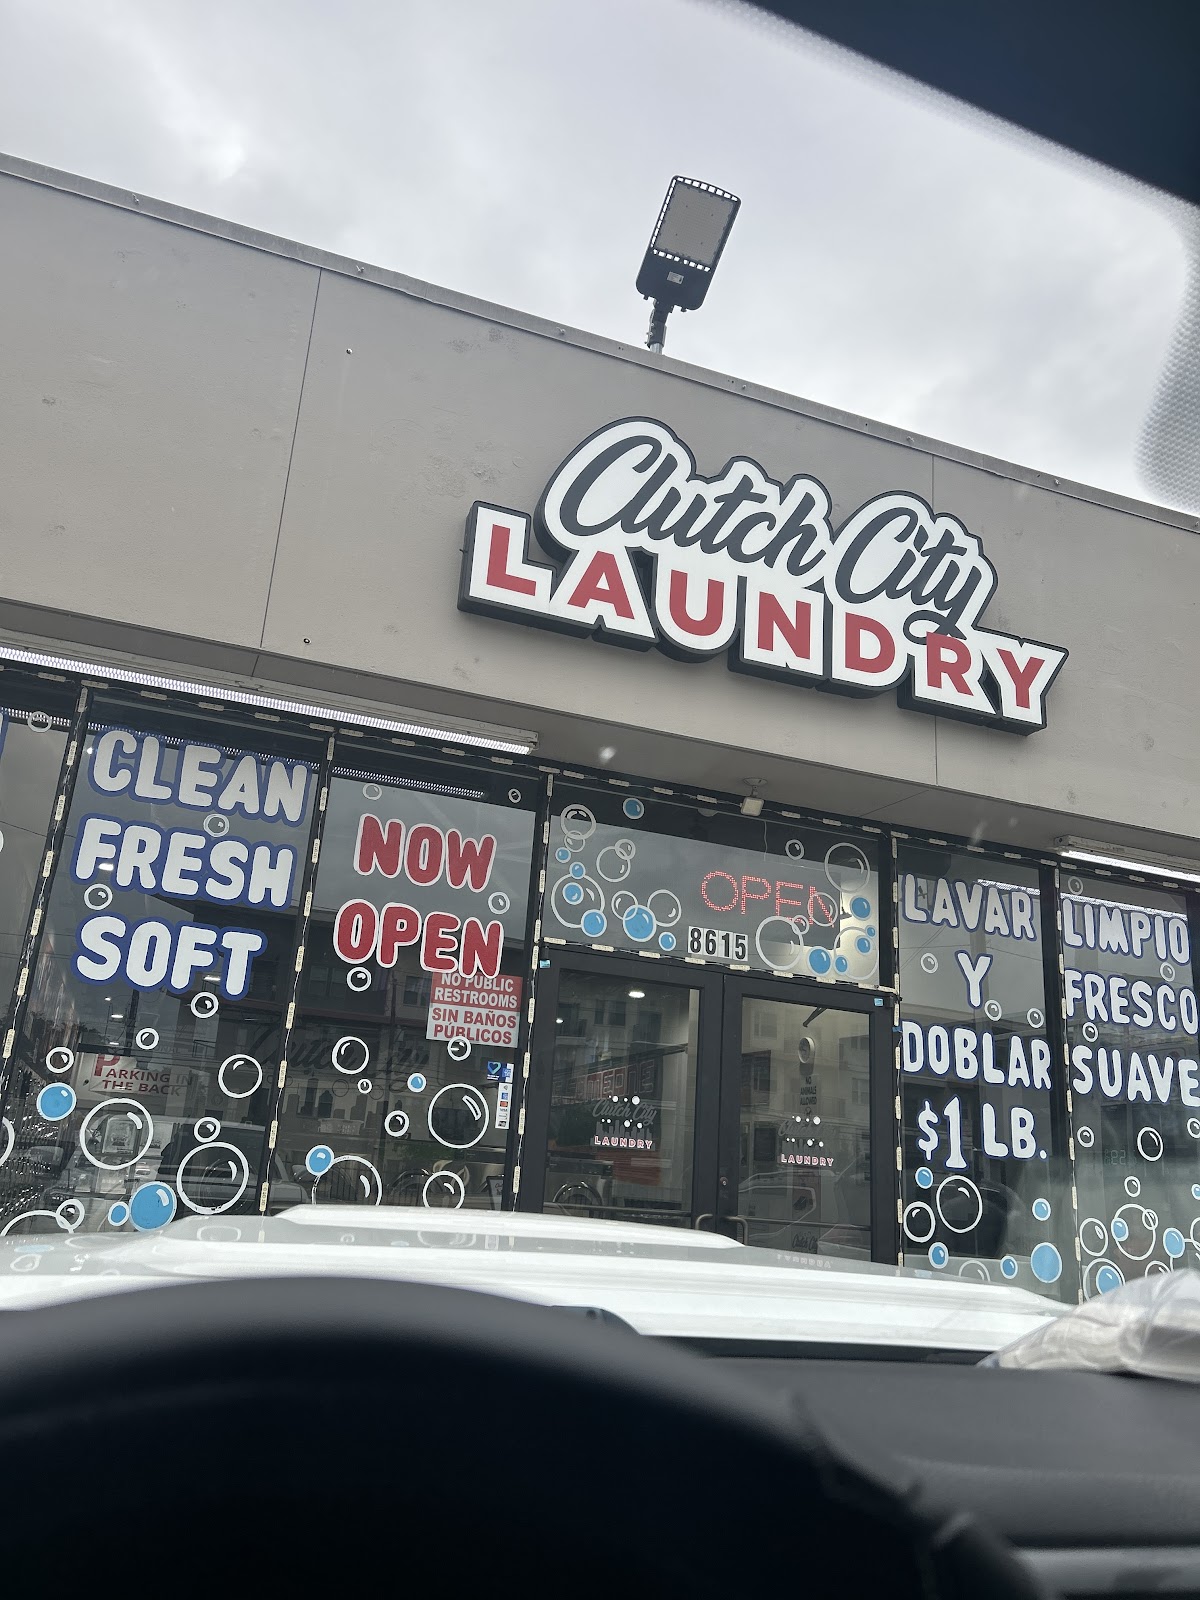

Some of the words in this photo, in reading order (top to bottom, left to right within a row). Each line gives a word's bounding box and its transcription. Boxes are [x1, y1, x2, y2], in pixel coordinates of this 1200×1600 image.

[559, 434, 827, 577] Clutch
[834, 506, 982, 644] City
[486, 524, 1045, 710] LAUNDRY
[92, 729, 309, 823] CLEAN
[75, 817, 294, 907] FRESH
[353, 812, 498, 893] NOW
[701, 870, 835, 928] OPEN
[902, 873, 1036, 939] LAVAR
[1062, 898, 1190, 964] LIMPIO
[76, 915, 263, 996] SOFT
[333, 898, 504, 979] OPEN
[689, 927, 748, 961] 8615
[434, 987, 518, 1009] RESTROOMS
[441, 972, 462, 987] NO
[464, 974, 514, 993] PUBLIC
[957, 952, 992, 1007] Y
[1064, 969, 1199, 1035] FRESCO
[432, 1007, 458, 1023] SIN
[464, 1010, 517, 1028] BAÑOS
[433, 1022, 512, 1045] PÚBLICOS
[902, 1020, 1052, 1090] DOBLAR
[1072, 1045, 1200, 1107] SUAVE
[102, 1079, 134, 1091] THE
[138, 1083, 180, 1096] BACK
[592, 1098, 632, 1118] Clutch
[632, 1102, 657, 1126] City
[593, 1134, 654, 1150] LAUNDRY
[780, 1153, 835, 1167] LAUNDRY
[917, 1095, 967, 1169] $1
[982, 1102, 1047, 1159] LB.
